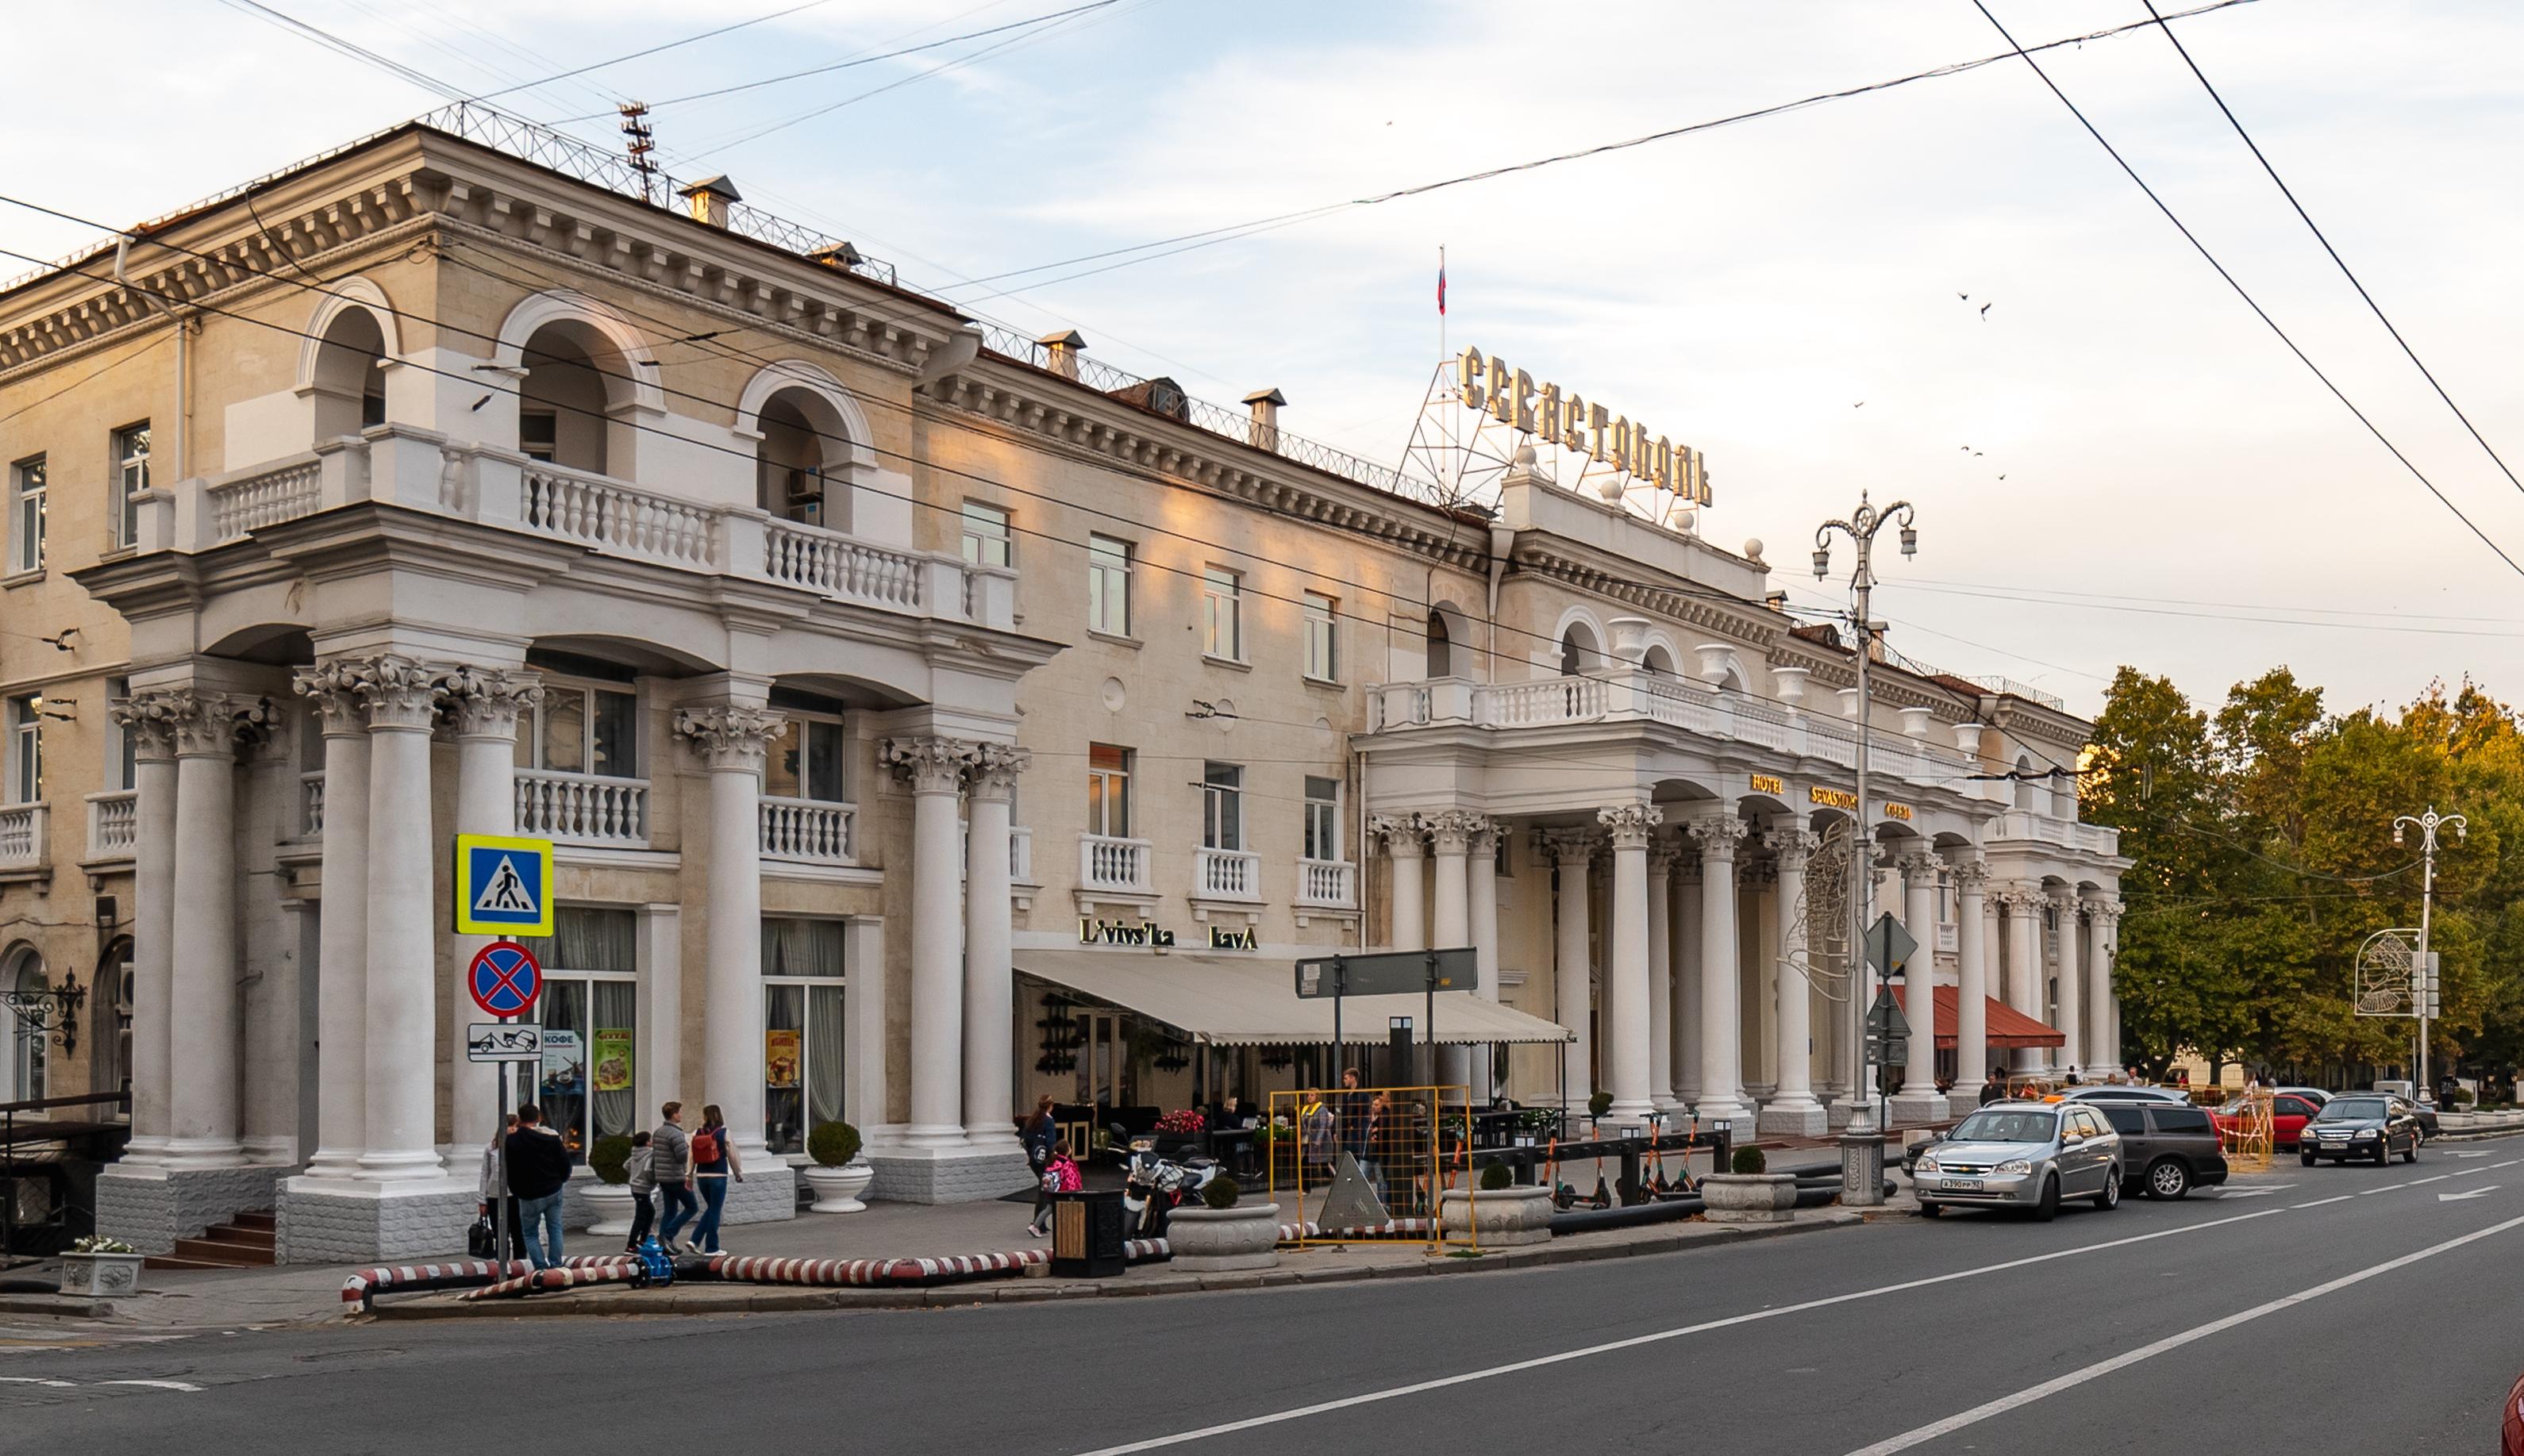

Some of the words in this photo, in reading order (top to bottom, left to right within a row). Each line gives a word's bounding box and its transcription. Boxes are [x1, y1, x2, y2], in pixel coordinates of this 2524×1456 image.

[1460, 344, 1712, 508] СЕВАСТОПОЛЬ
[1751, 774, 1784, 794] HOTEL
[544, 1035, 574, 1043] КОФЕ
